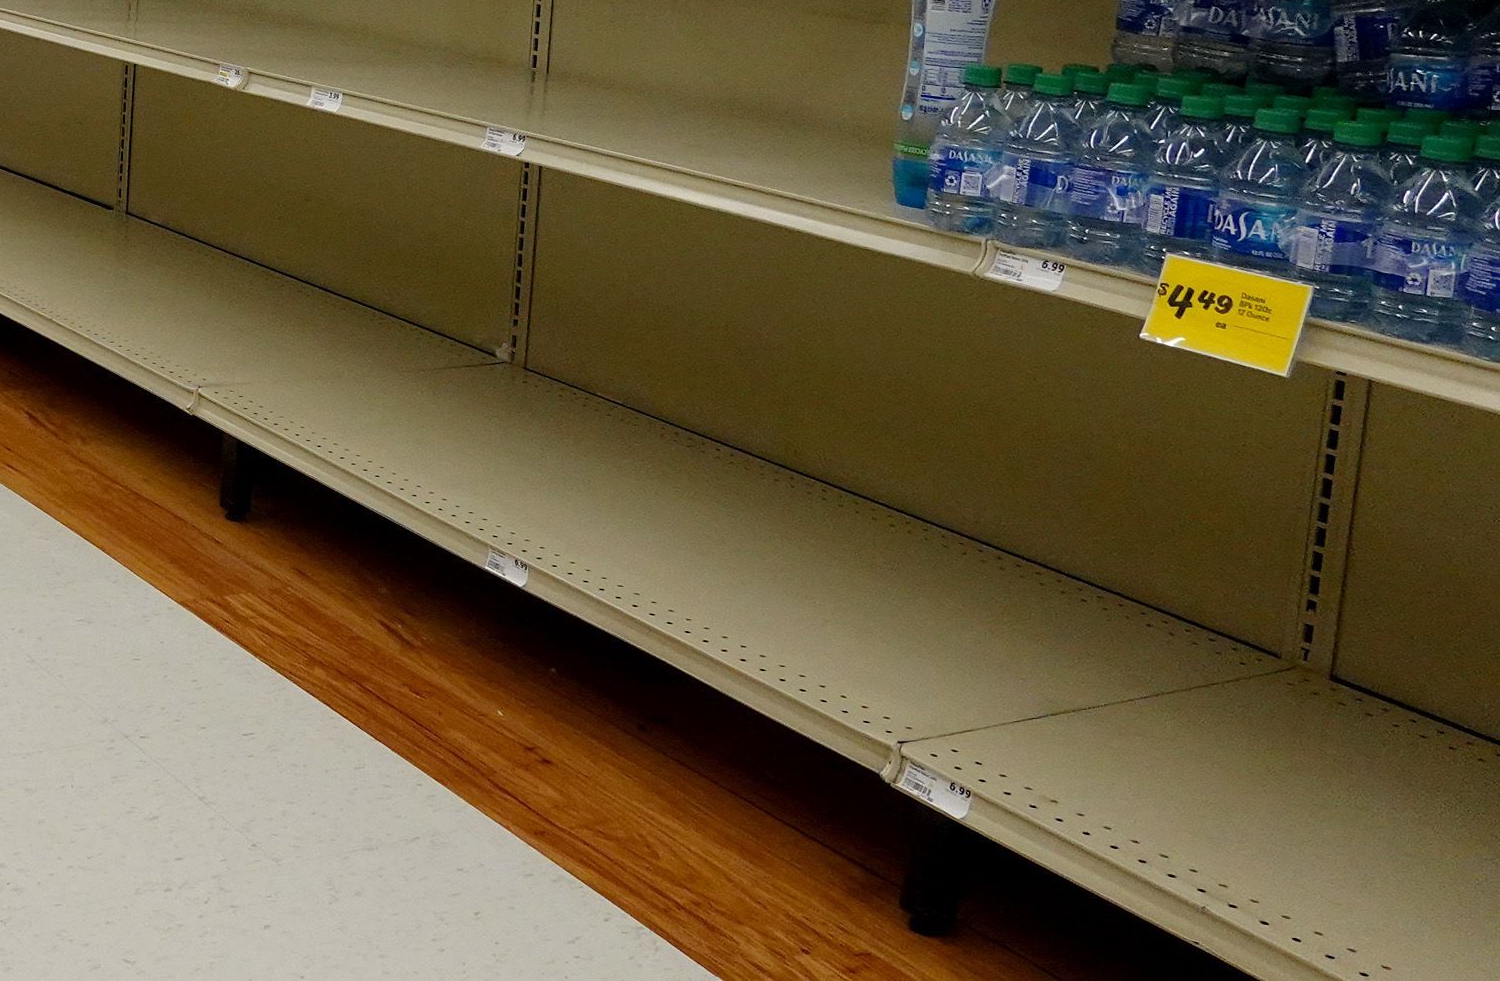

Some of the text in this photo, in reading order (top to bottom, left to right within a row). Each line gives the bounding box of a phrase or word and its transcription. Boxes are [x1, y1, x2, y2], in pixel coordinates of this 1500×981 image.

[1254, 5, 1320, 32] ASANI
[1386, 68, 1440, 93] SANI
[1021, 158, 1031, 187] AGAIN
[1169, 186, 1180, 218] AGAIN
[1160, 199, 1171, 234] RECYCLE
[1213, 209, 1282, 243] DASAN
[1325, 220, 1337, 252] AGAIN
[1411, 241, 1456, 257] DASAN
[1041, 260, 1066, 273] 6.99
[1240, 292, 1266, 304] Dasani
[1215, 321, 1227, 330] ea
[1238, 308, 1270, 323] 12 Ounce
[949, 782, 972, 799] 6.99
